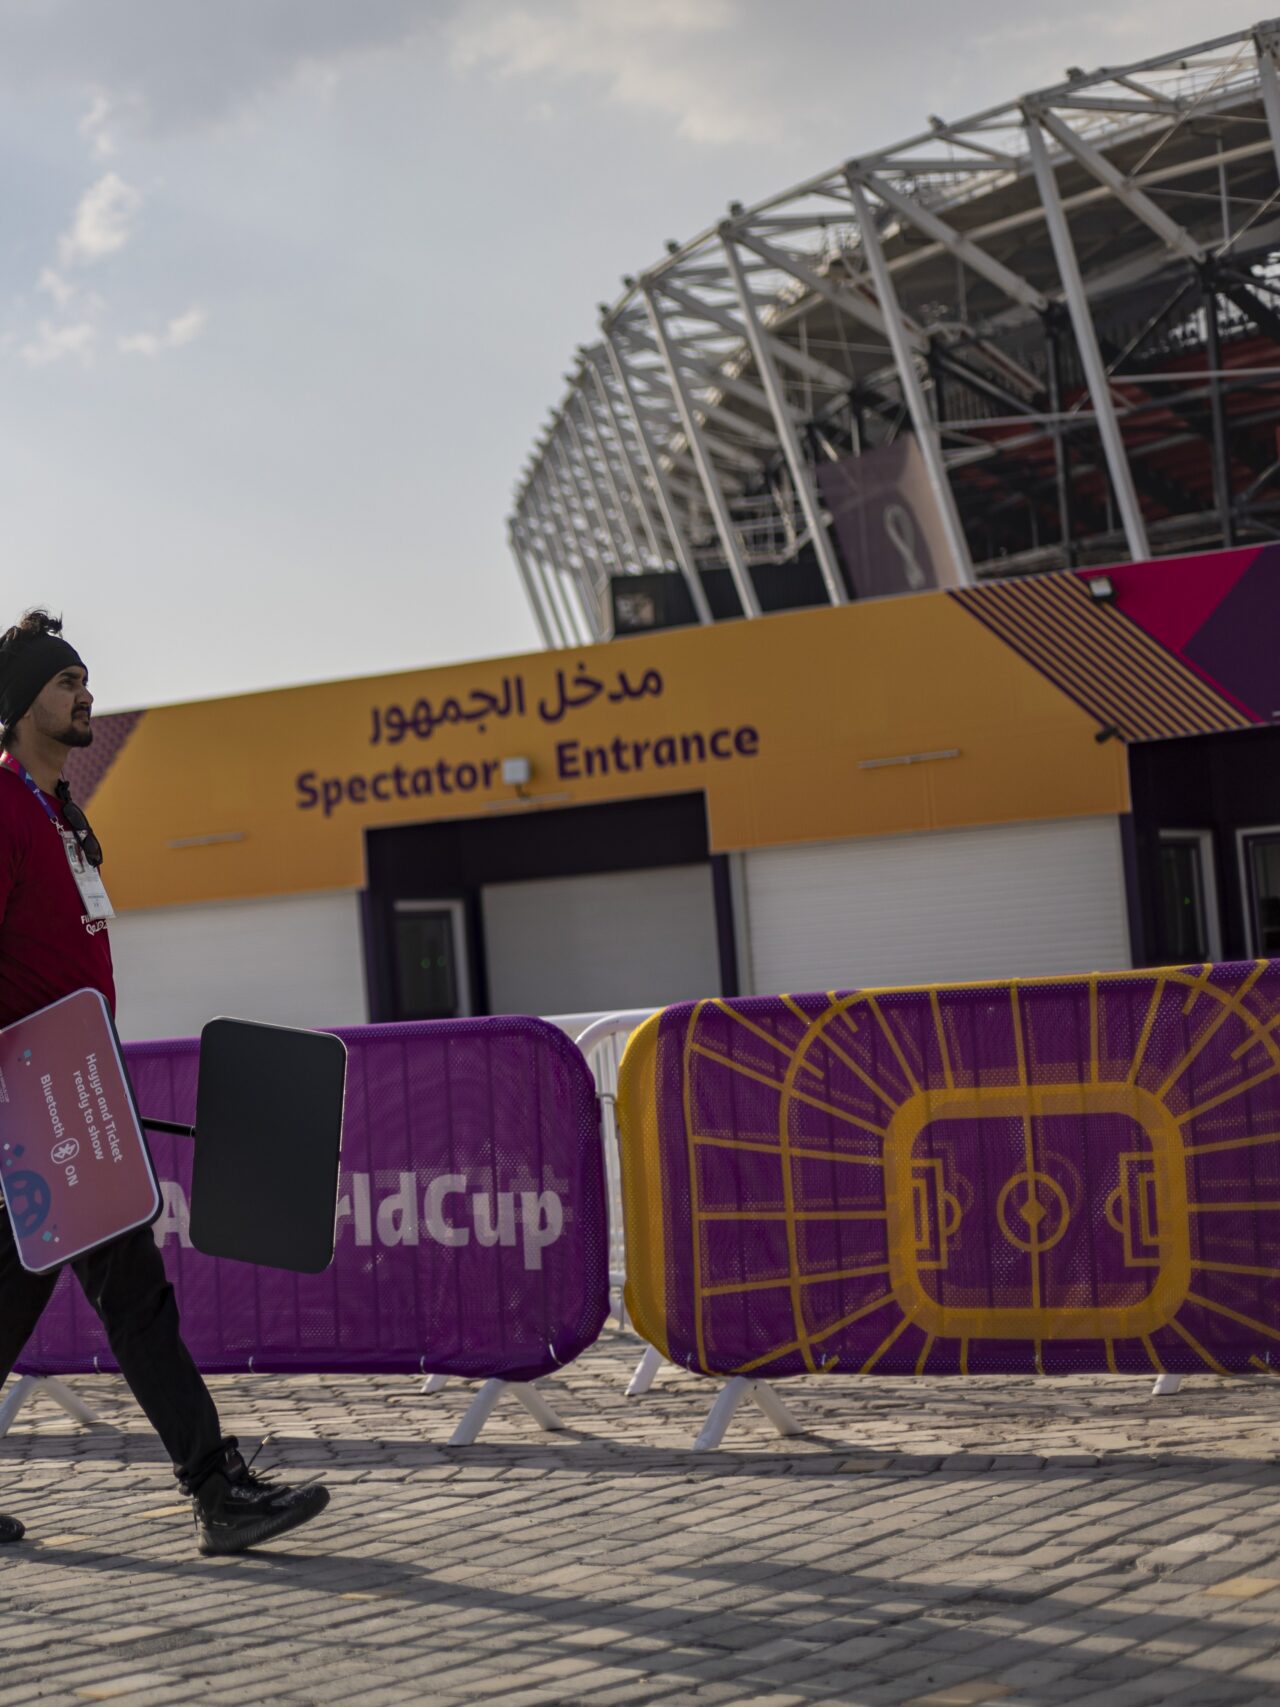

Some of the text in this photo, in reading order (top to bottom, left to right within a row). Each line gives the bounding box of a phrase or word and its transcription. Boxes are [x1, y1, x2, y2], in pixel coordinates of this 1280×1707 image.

[369, 662, 664, 747] مدخل الجمهور
[294, 725, 760, 817] Spectator Entrance
[40, 1073, 79, 1187] Bluetooth ON
[73, 1070, 104, 1160] ready to show
[86, 1053, 123, 1163] Hayya and Ticket
